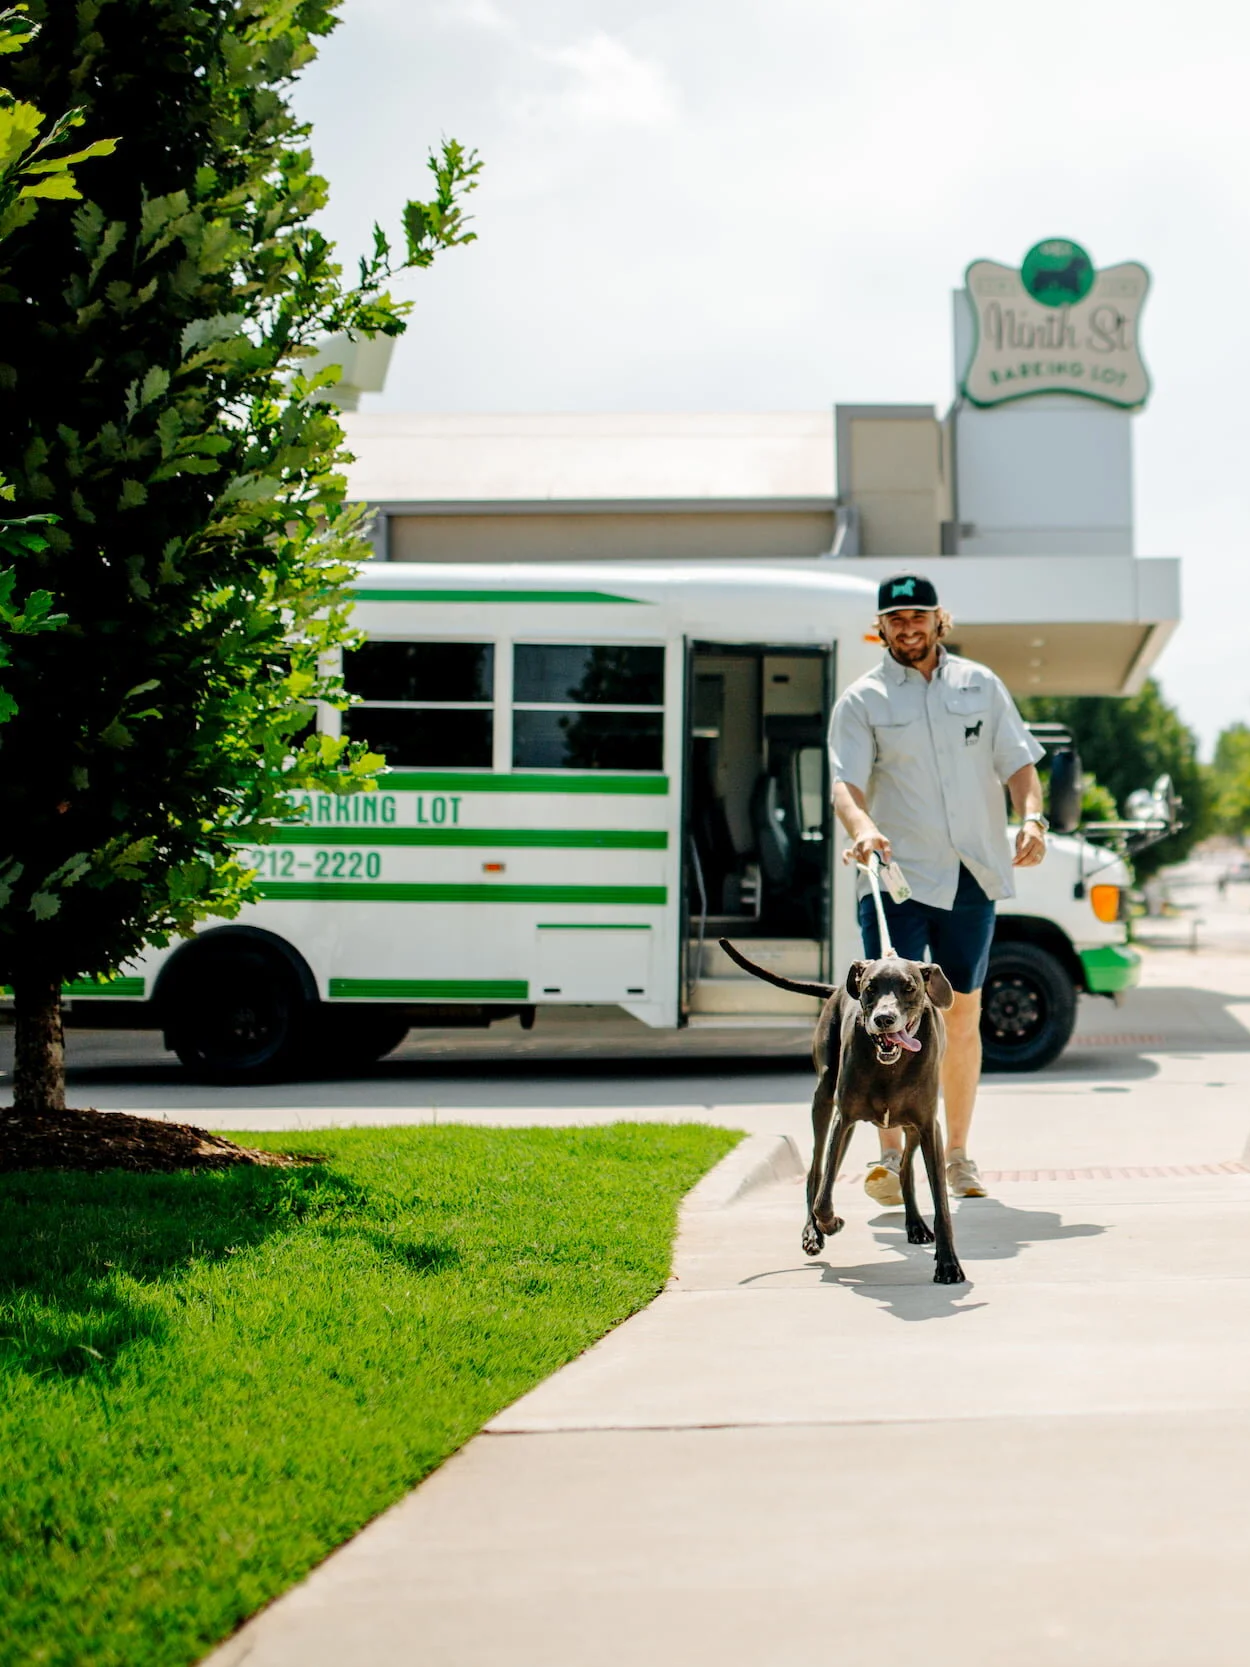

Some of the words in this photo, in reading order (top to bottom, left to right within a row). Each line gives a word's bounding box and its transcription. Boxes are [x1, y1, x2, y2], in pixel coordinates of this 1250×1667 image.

[984, 301, 1077, 352] Ninth
[1085, 304, 1132, 354] St
[1091, 367, 1129, 388] LOT
[416, 796, 463, 824] LOT
